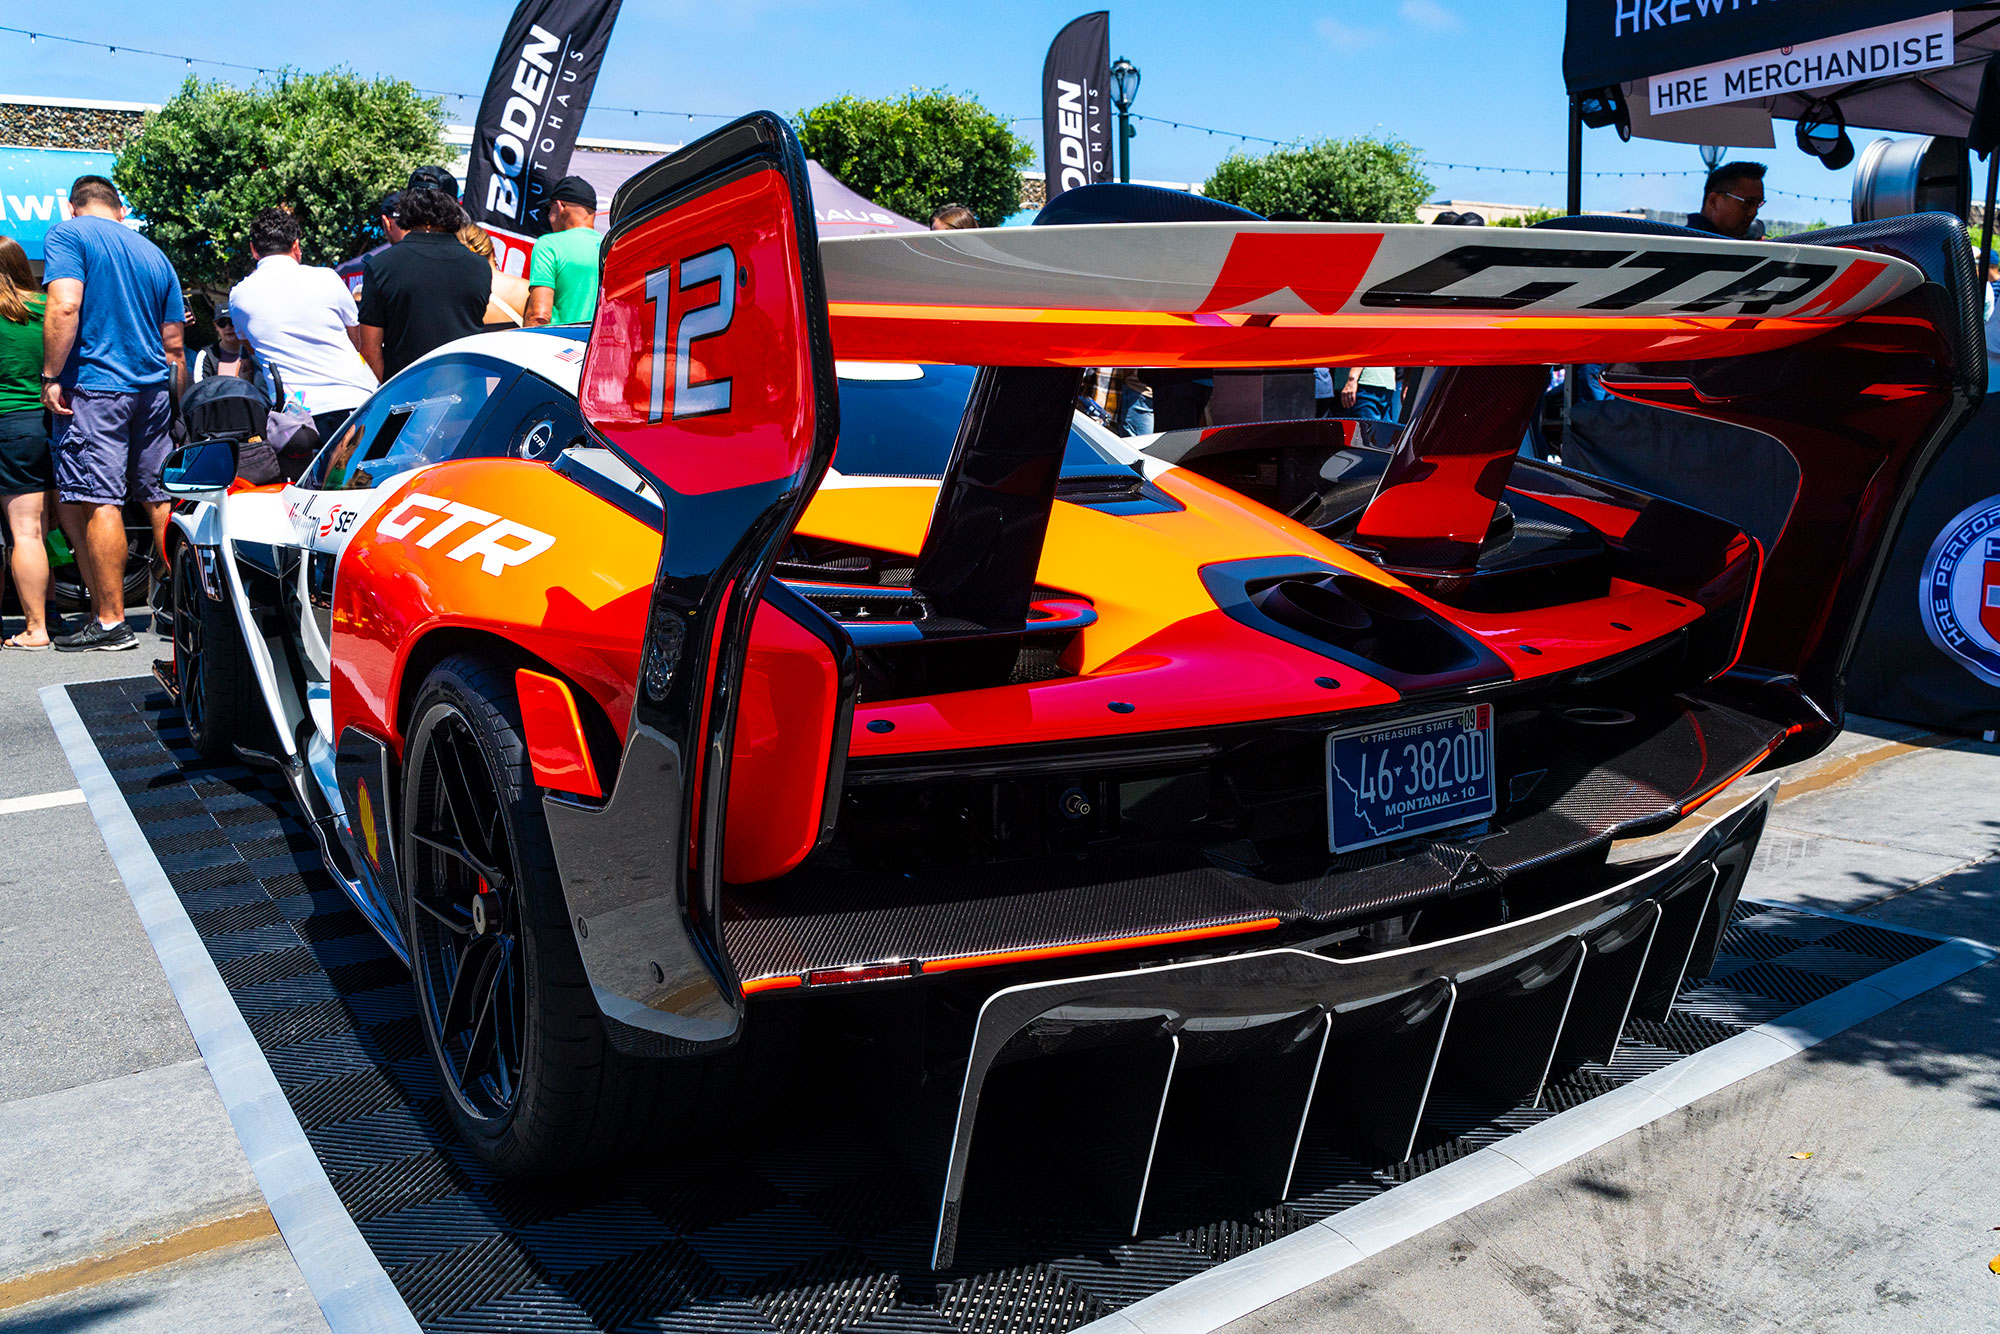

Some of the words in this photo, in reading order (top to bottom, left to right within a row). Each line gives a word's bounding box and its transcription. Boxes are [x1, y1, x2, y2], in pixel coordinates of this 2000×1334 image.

[1657, 76, 1708, 108] HRE
[1725, 33, 1944, 97] MERCHANDISE
[486, 24, 561, 219] BODEN
[529, 50, 584, 221] AUTOHAUS
[1057, 79, 1087, 192] ODEN
[1089, 89, 1103, 175] OHAUS
[1359, 245, 1838, 314] GTR
[644, 243, 737, 425] 12
[376, 493, 556, 577] GTR
[1935, 598, 1966, 647] HRE
[1371, 724, 1423, 743] TREASURE
[1426, 720, 1454, 733] STATE
[1465, 709, 1475, 730] 09
[1385, 792, 1450, 816] MONTANA
